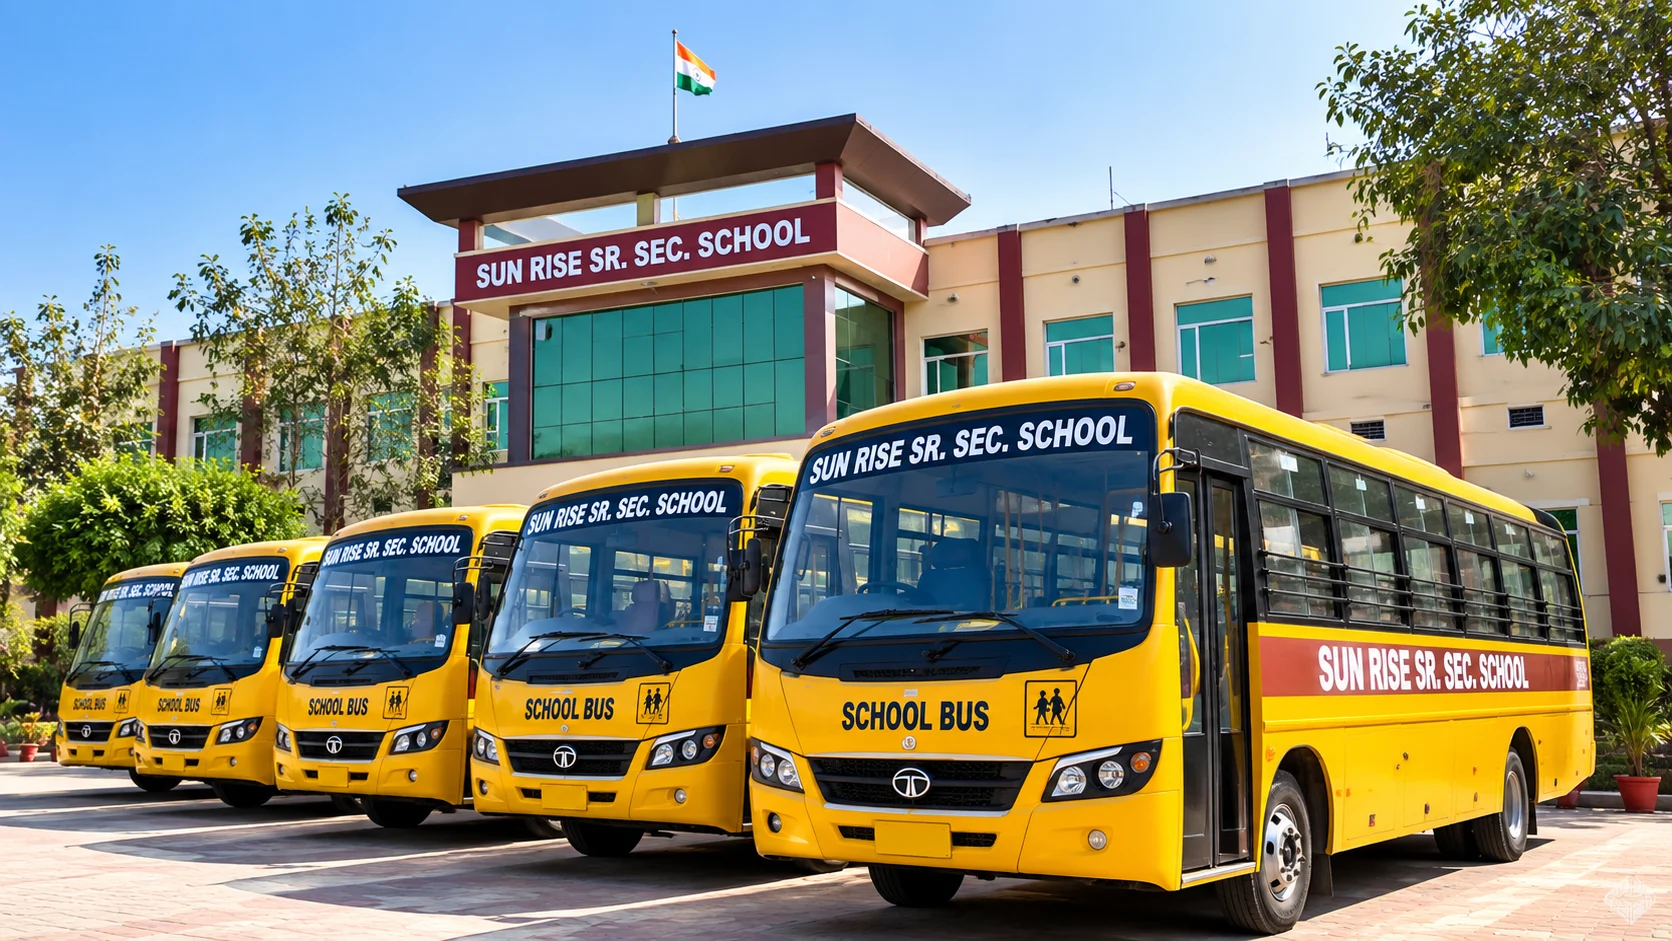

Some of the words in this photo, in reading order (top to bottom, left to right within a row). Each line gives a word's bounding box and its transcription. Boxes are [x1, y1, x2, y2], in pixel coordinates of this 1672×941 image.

[476, 258, 522, 289] SUN
[530, 250, 582, 281] RISE
[589, 245, 627, 273] SR.
[634, 236, 690, 267] SEC.
[698, 217, 811, 258] SCHOOL
[809, 450, 851, 485] SUN
[854, 439, 904, 475] RISE
[908, 433, 946, 465] SR.
[953, 425, 1009, 458] SEC.
[1017, 415, 1133, 450] SCHOOL
[527, 510, 553, 536] SUN
[554, 500, 588, 530] RISE
[589, 500, 612, 524] SR.
[616, 495, 650, 519] SEC.
[655, 491, 727, 516] SCHOOL
[322, 549, 341, 567] SUN
[342, 544, 365, 563] RISE
[363, 541, 380, 558] SR.
[382, 537, 407, 556] SEC.
[410, 535, 461, 555] SCHOOL
[241, 564, 280, 580] SCHOOL
[1318, 645, 1363, 692] SUN
[1368, 647, 1412, 691] RISE
[1414, 649, 1441, 690] SR.
[1444, 651, 1477, 690] SEC.
[1479, 653, 1529, 689] SCHOOL
[157, 698, 183, 712] SCHOOL
[184, 698, 200, 712] BUS
[308, 698, 344, 716] SCHOOL
[347, 697, 369, 716] BUS
[524, 698, 580, 721] SCHOOL
[583, 697, 615, 720] BUS
[841, 701, 932, 731] SCHOOL
[939, 700, 989, 731] BUS
